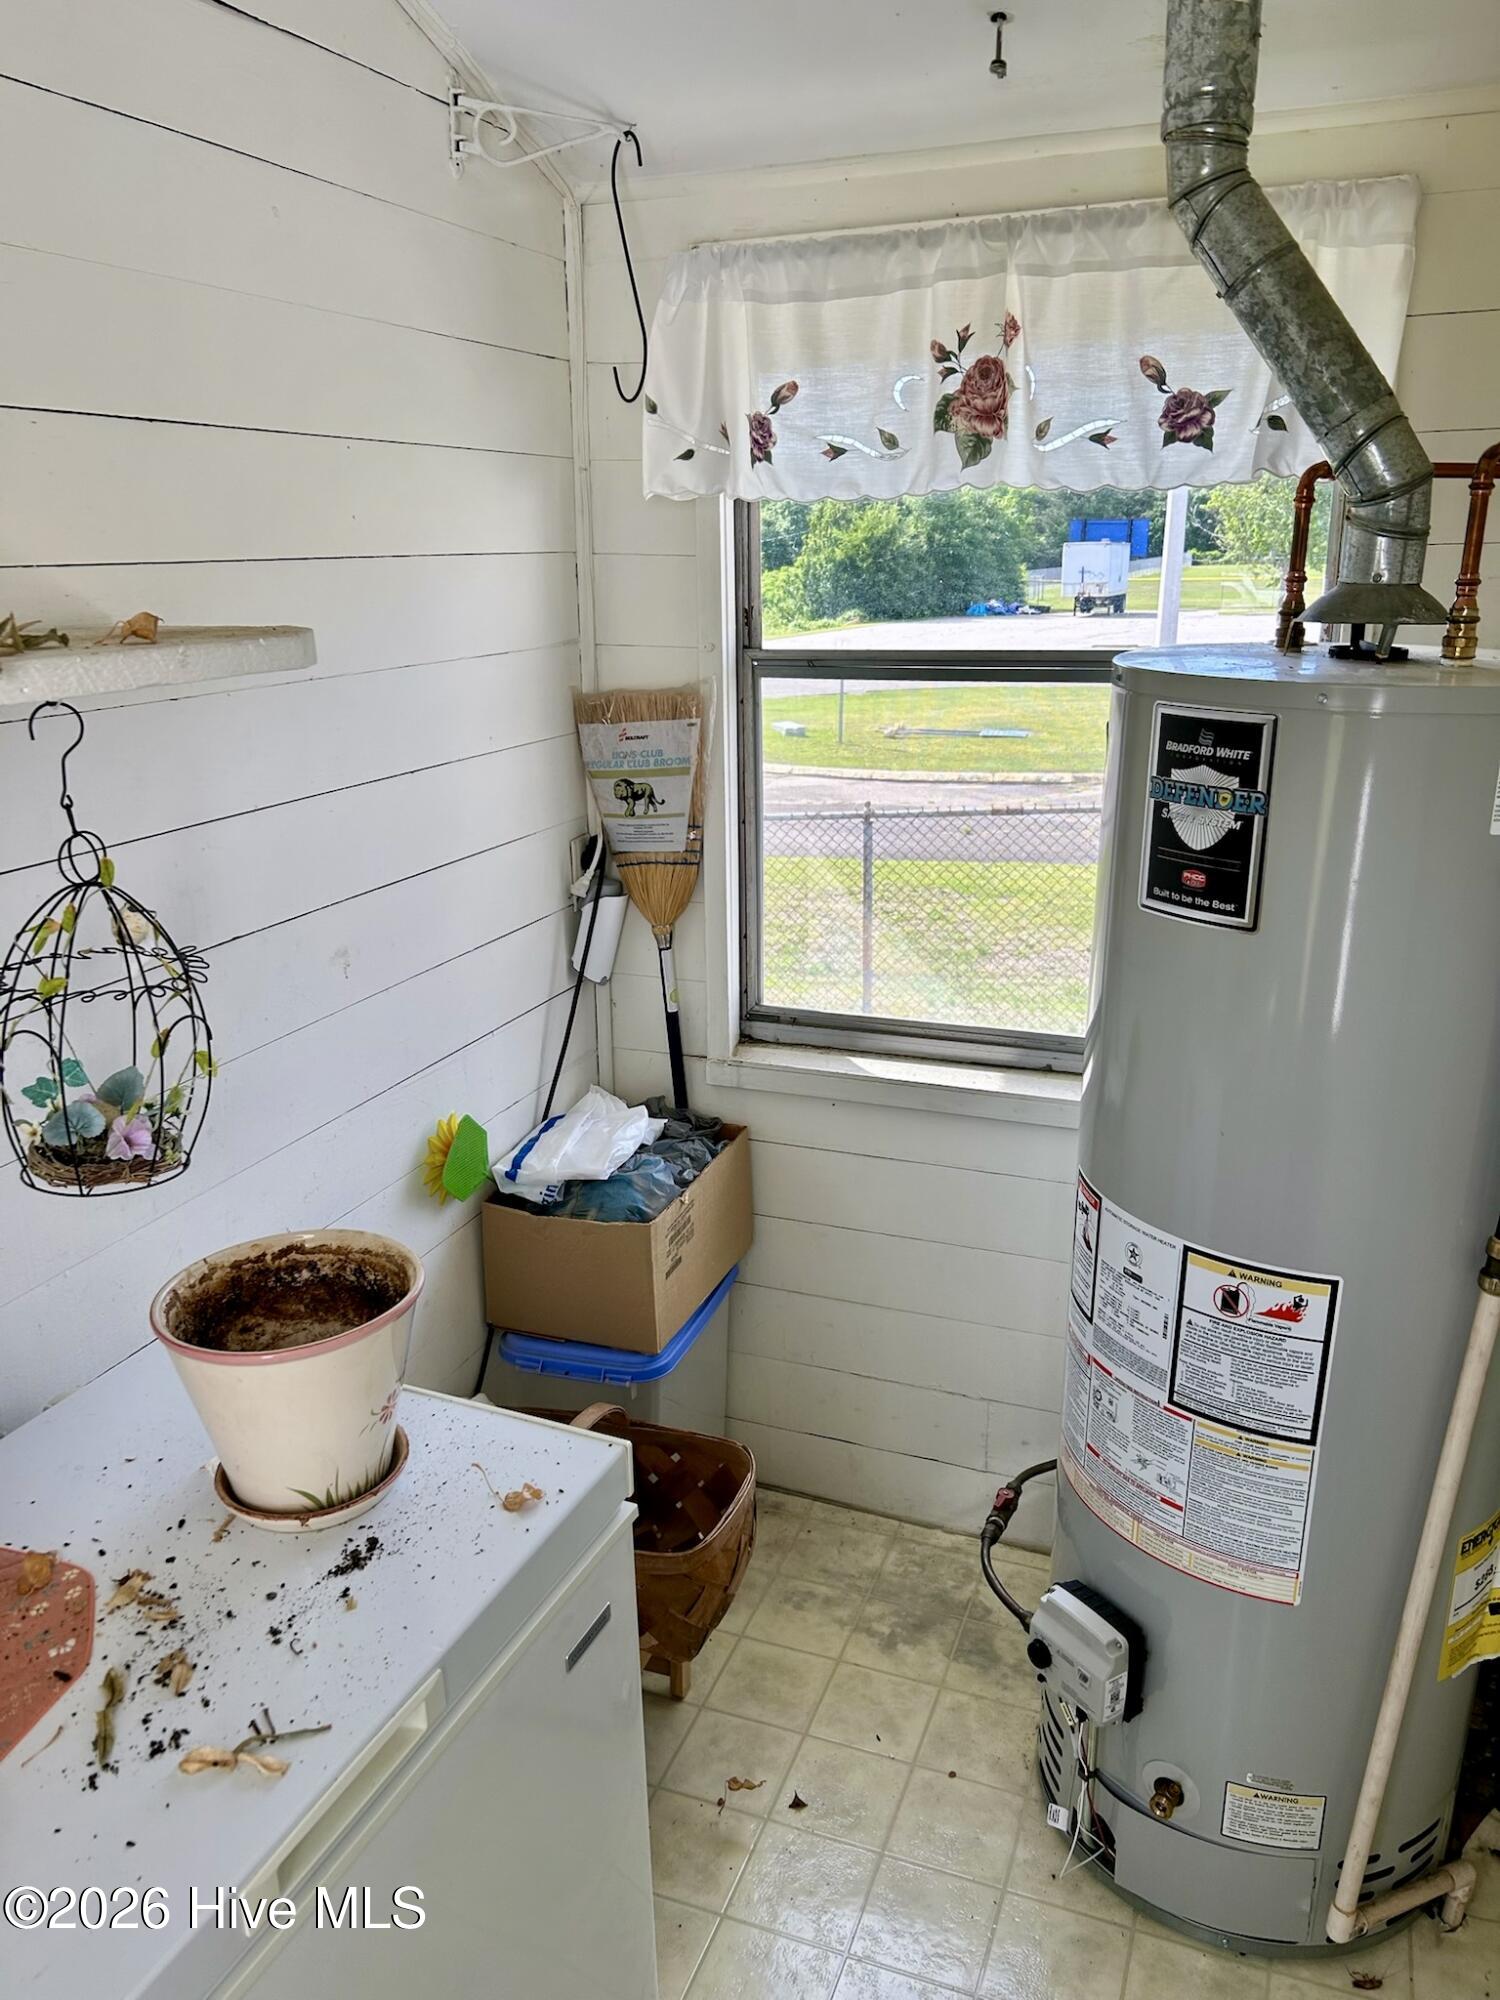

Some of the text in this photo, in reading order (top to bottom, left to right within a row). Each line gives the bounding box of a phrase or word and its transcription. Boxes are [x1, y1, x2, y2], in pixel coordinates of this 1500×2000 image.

[1165, 740, 1251, 761] BRADFORD WHITE
[1150, 775, 1268, 817] DEFENDER
[1153, 887, 1236, 912] Built to be the Best
[1239, 1272, 1283, 1289] WARNING
[1260, 1793, 1299, 1805] WARNING
